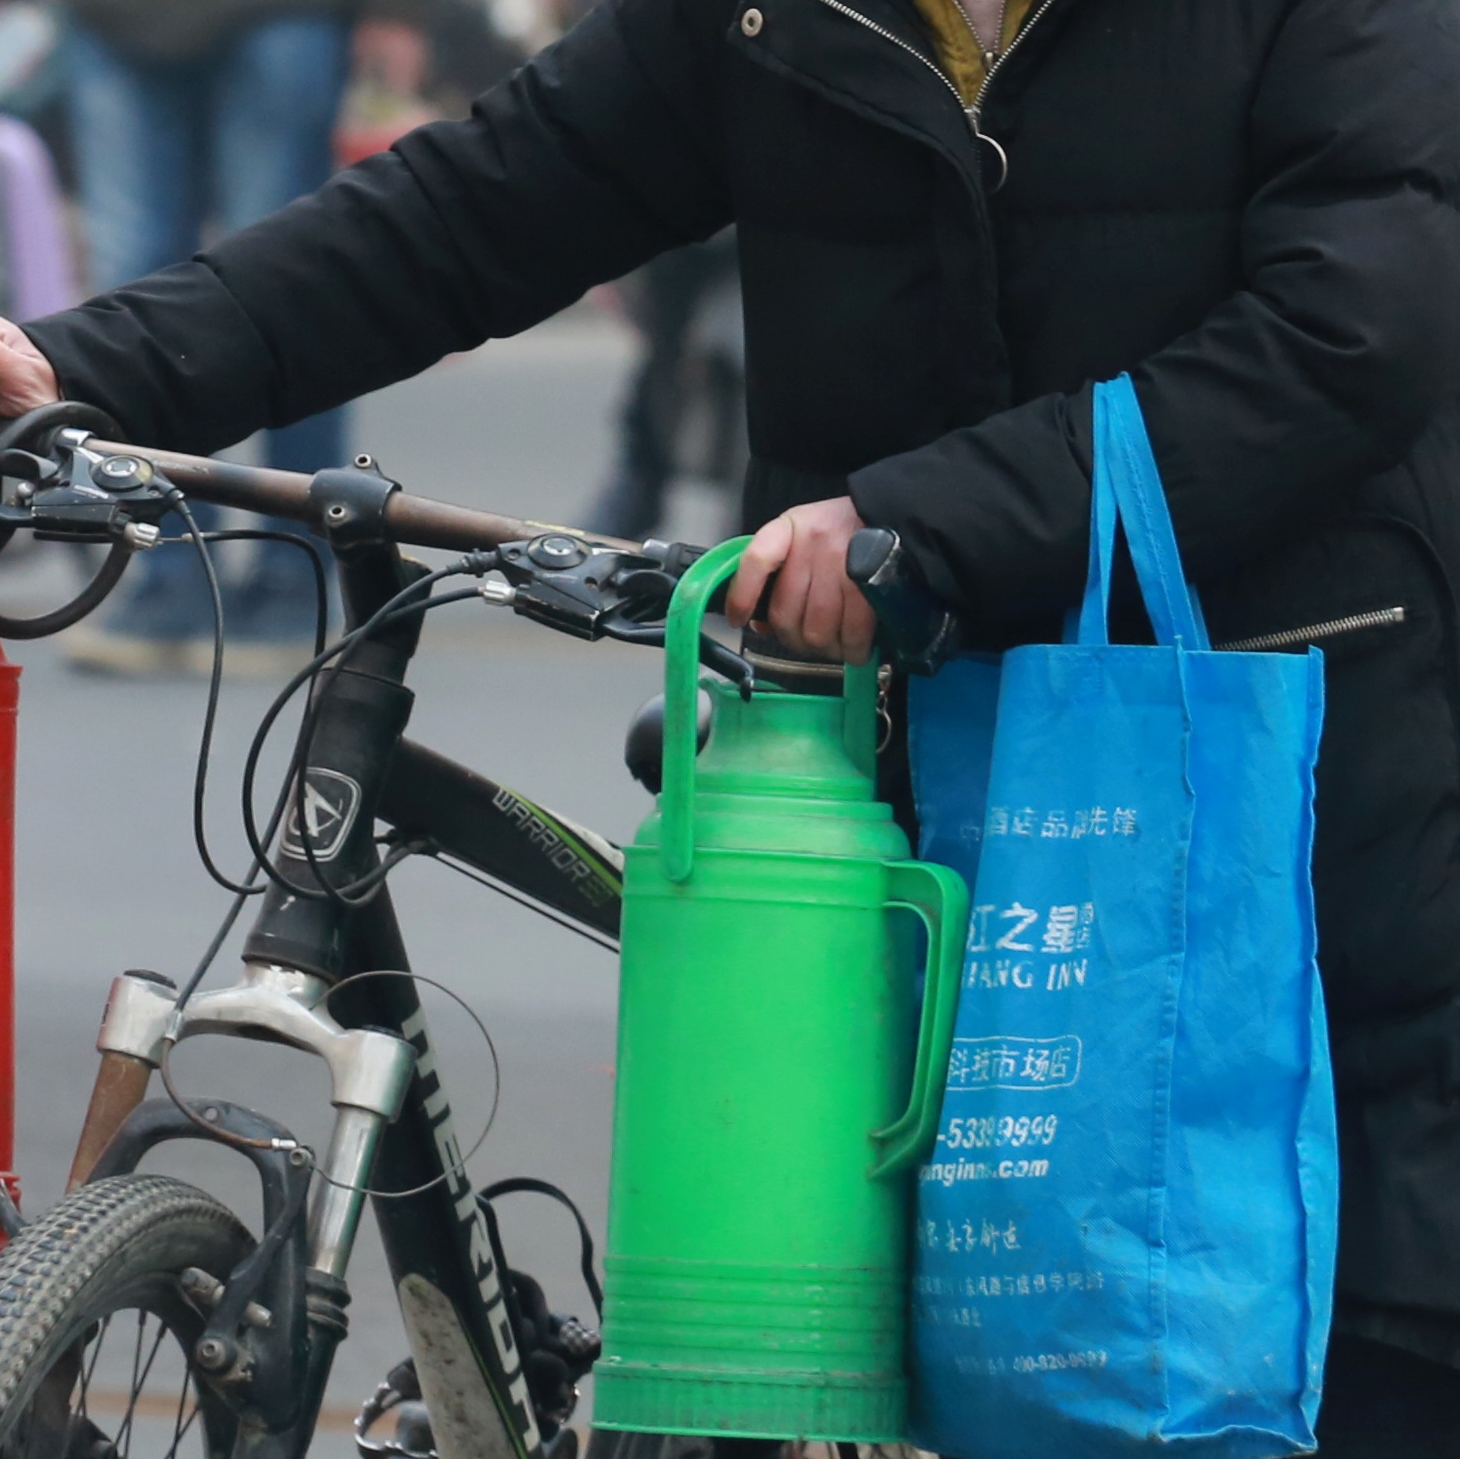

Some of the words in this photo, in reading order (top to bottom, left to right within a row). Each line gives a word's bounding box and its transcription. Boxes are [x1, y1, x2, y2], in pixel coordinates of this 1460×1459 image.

[492, 788, 590, 882] WARRIOR
[961, 958, 1035, 989] IANG
[401, 1004, 541, 1453] MERIDA
